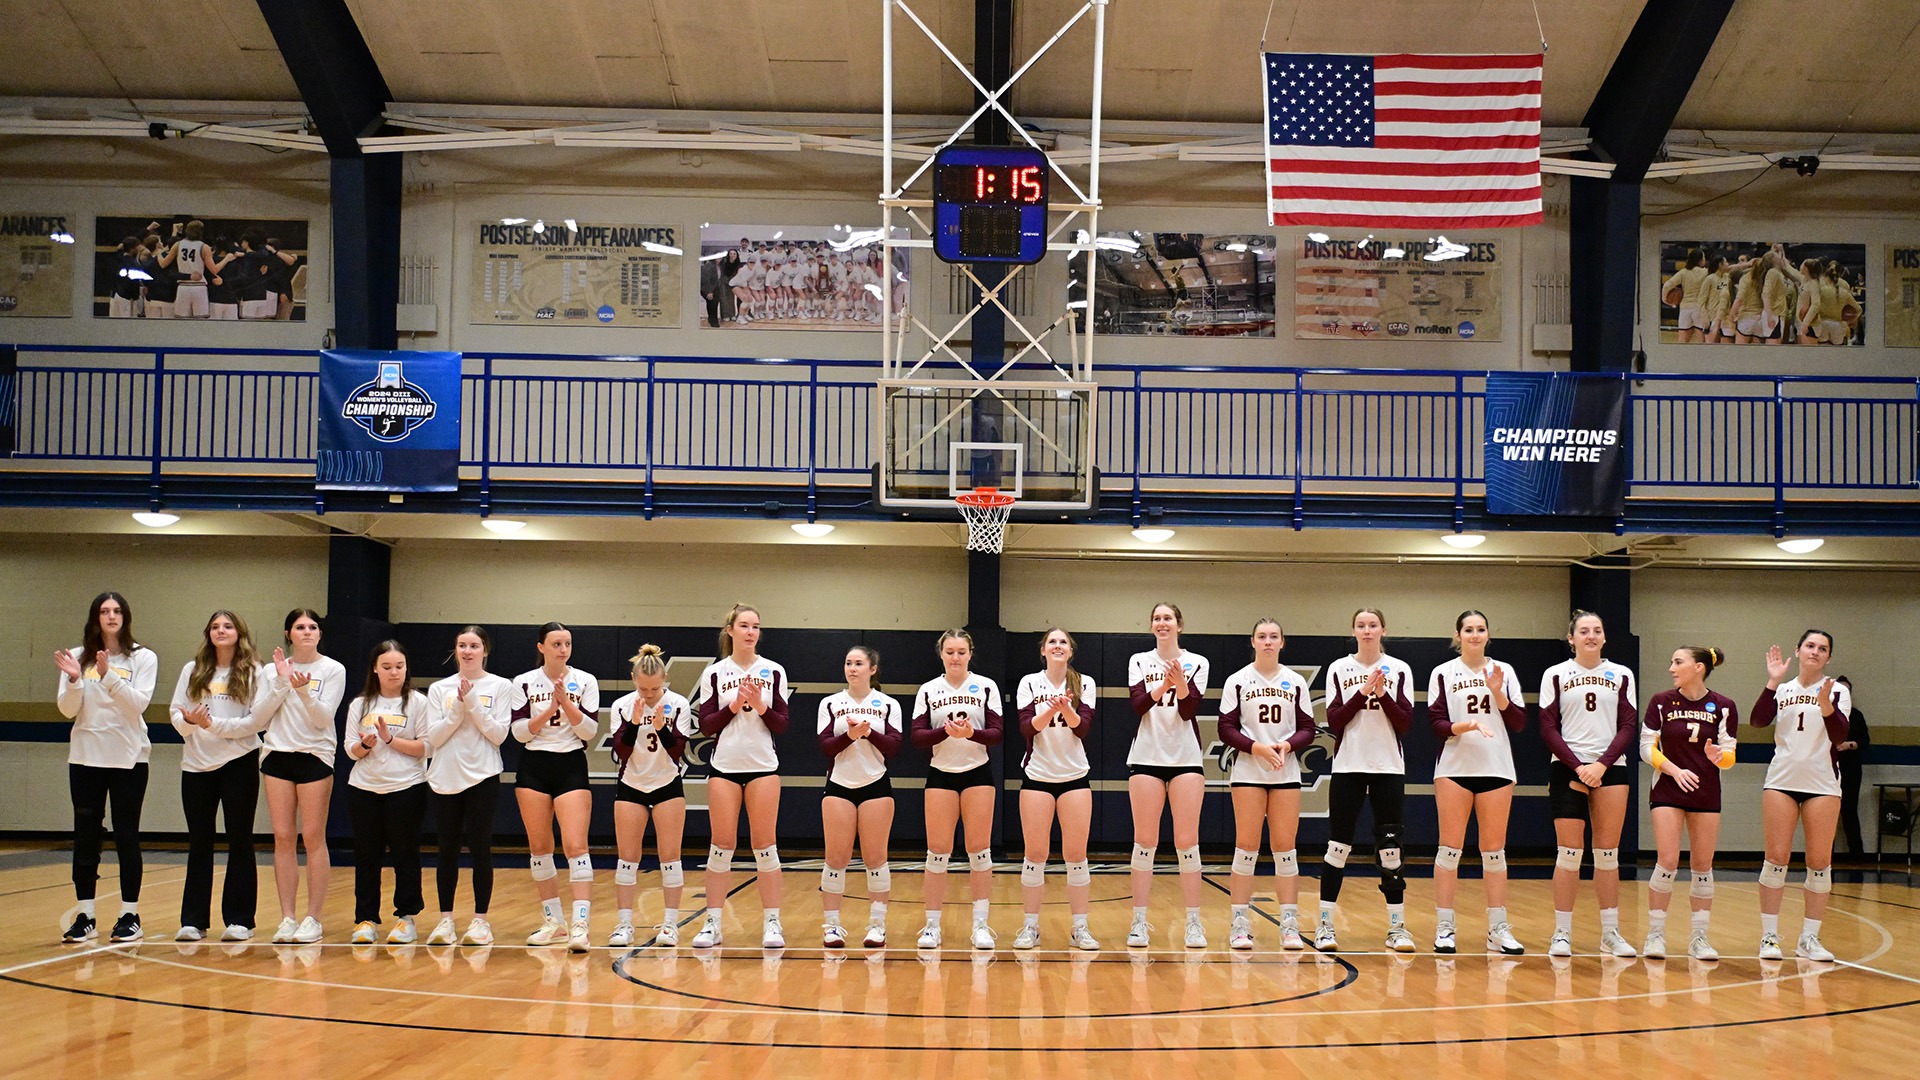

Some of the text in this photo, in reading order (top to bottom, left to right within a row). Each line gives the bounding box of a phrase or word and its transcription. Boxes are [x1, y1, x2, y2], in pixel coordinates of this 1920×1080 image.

[977, 167, 1040, 201] 1:15
[480, 224, 675, 247] POSTSEASON APPEARANCES
[181, 248, 196, 262] 34
[1414, 324, 1452, 335] molten
[345, 403, 434, 416] CHAMPIONSHIP
[1492, 427, 1617, 446] CHAMPIONS
[1503, 445, 1545, 462] WIN
[1343, 674, 1394, 690] SALISRY
[1452, 678, 1485, 694] SALISB
[1563, 676, 1617, 692] SALISBURY
[931, 695, 982, 711] SALISBURY
[1245, 687, 1295, 703] SALISBURY
[1585, 692, 1597, 712] 8
[1467, 694, 1491, 714] 24
[836, 707, 883, 719] SALISBURY
[1258, 703, 1282, 724] 20
[1797, 711, 1805, 731] 1
[1686, 721, 1700, 743] 7
[646, 732, 658, 753] 3
